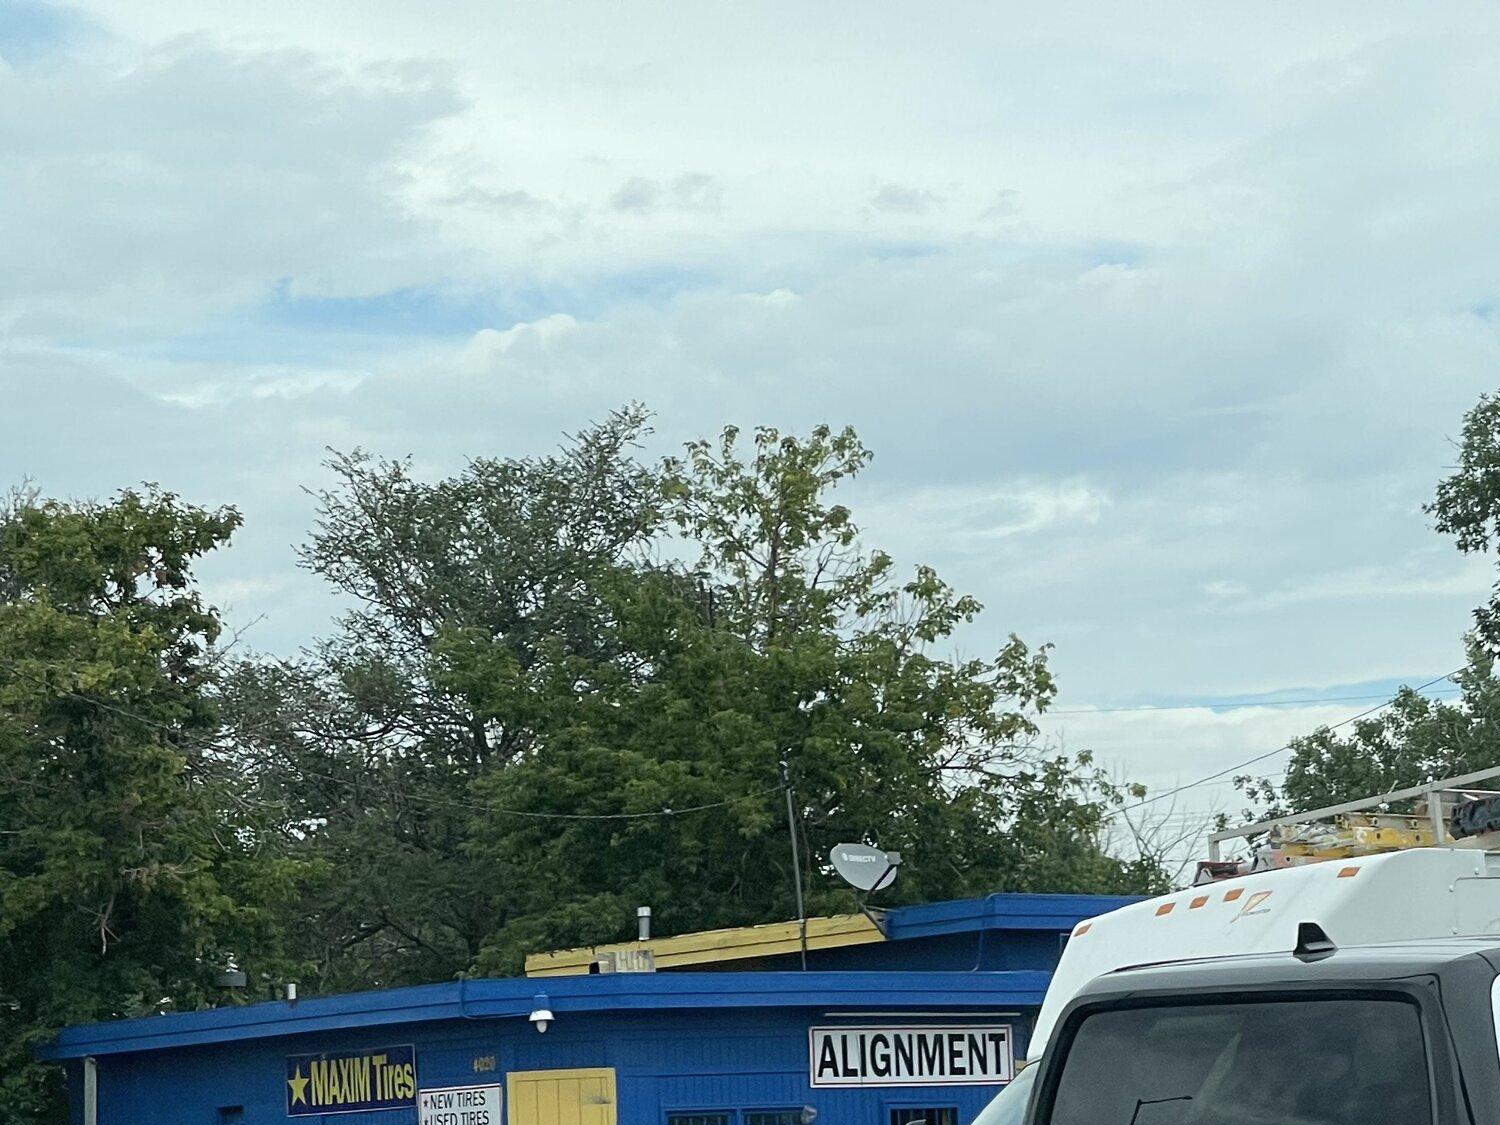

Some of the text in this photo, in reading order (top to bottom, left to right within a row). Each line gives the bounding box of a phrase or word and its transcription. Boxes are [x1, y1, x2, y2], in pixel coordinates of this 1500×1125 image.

[817, 1033, 1006, 1078] ALIGNMENT
[310, 1053, 416, 1106] MAXIM Tires
[430, 1090, 486, 1110] NEW TIRES
